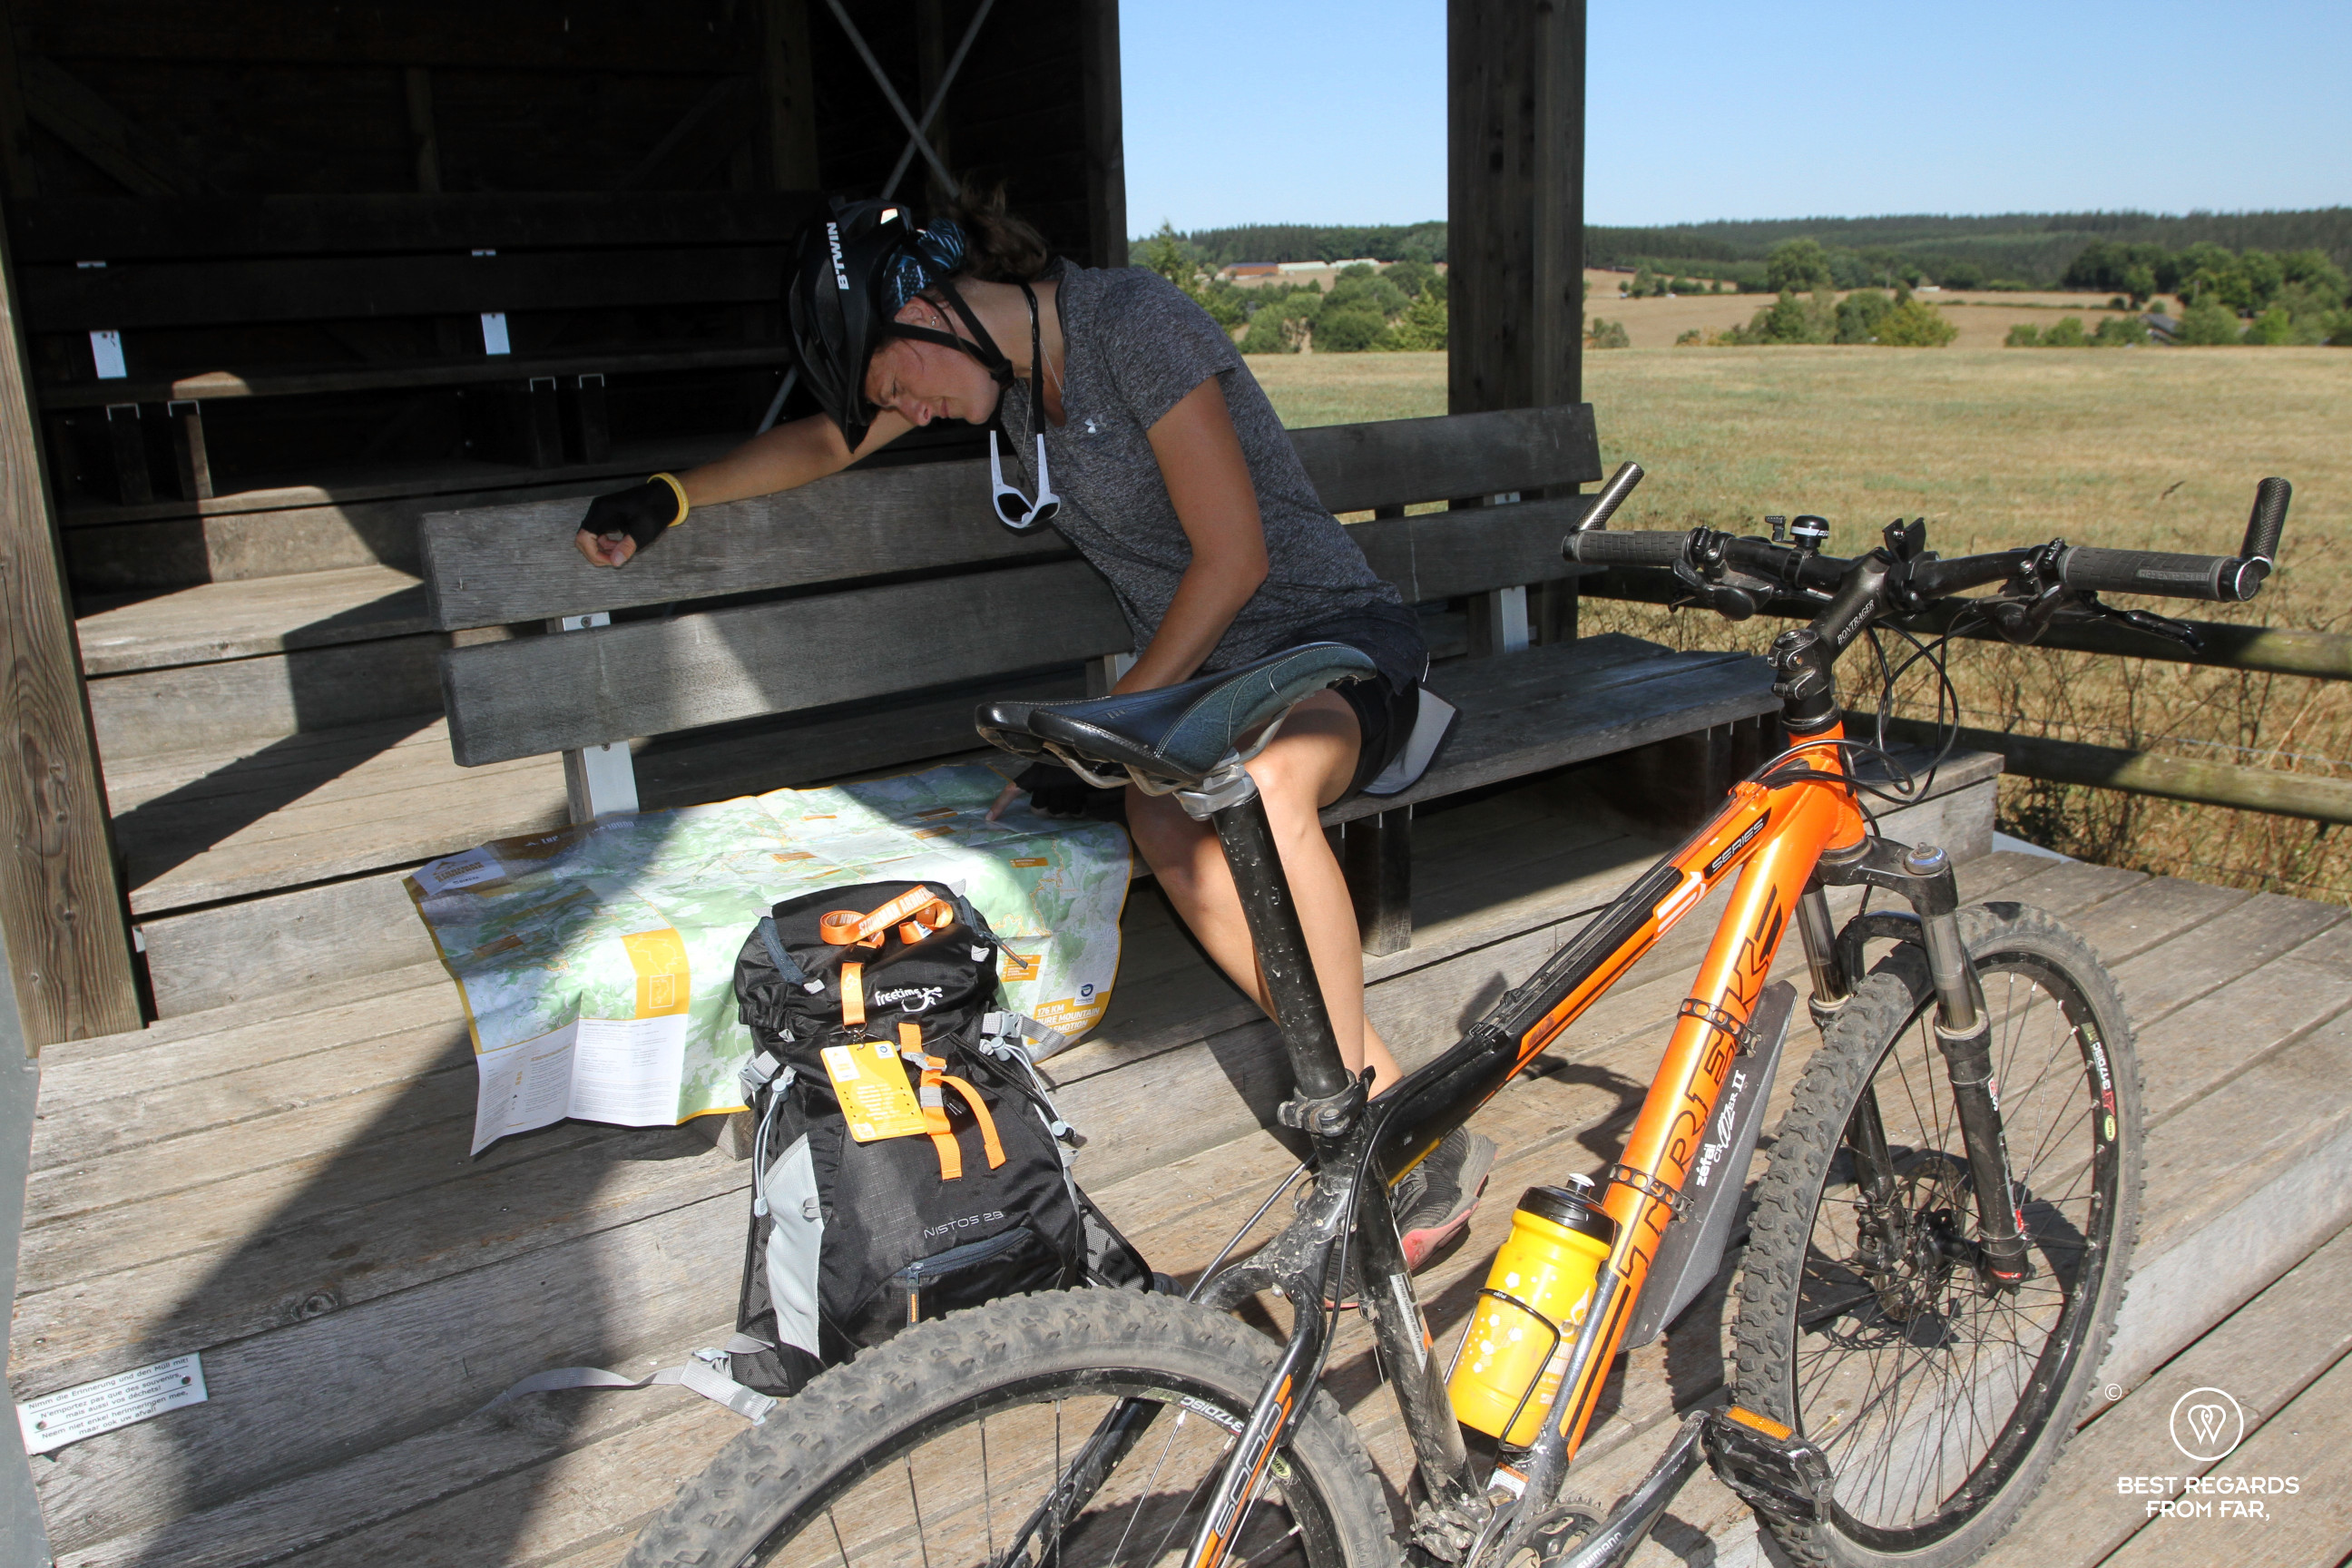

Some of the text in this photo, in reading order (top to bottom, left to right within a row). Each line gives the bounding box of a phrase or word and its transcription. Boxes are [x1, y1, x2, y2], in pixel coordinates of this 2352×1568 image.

[1837, 599, 1875, 645] BONTRAGER
[1711, 818, 1765, 873] SERIES
[875, 988, 921, 1006] freetime
[1037, 1004, 1065, 1016] 176 KM
[1059, 1007, 1100, 1022] MOUNTAIN
[1696, 1142, 1717, 1186] zéfal
[924, 1215, 980, 1240] NISTOS
[28, 1357, 189, 1409] Nimm die Erinnerung und den Müll mit!
[40, 1372, 182, 1418] N'emportez pas que des souvenirs,
[65, 1385, 162, 1419] mais aussi vos déchets!
[42, 1390, 189, 1439] Neem niet enkel herinneringen mee,
[79, 1406, 157, 1436] maar ook uw afval!
[1215, 1403, 1283, 1539] 6000
